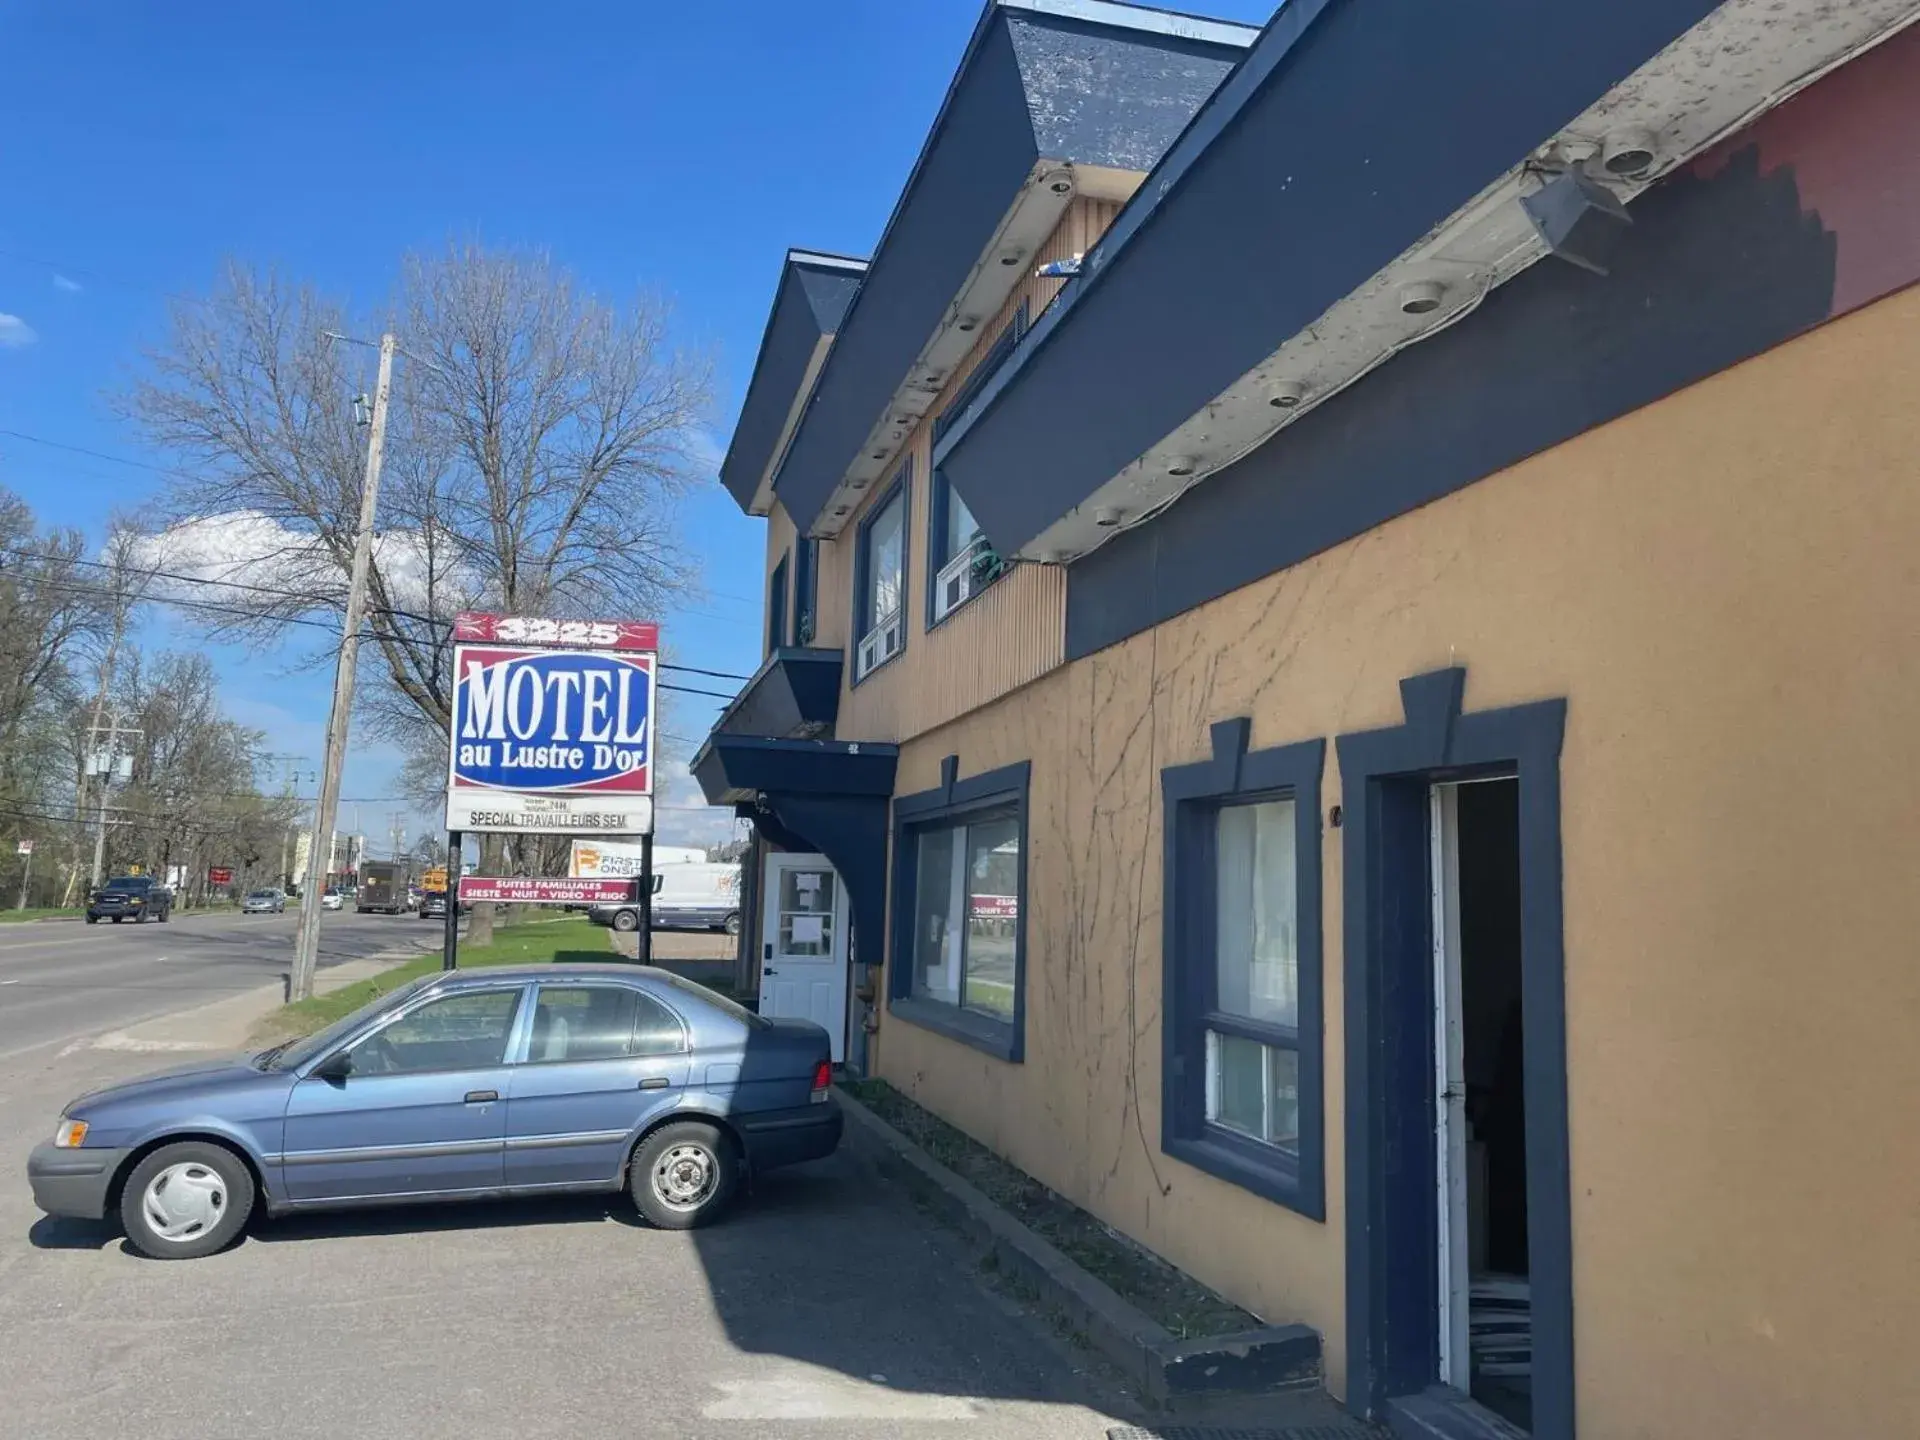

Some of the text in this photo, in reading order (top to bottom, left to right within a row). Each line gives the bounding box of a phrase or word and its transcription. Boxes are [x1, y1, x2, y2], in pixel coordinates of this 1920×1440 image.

[495, 617, 620, 645] 3225
[462, 660, 646, 743] MOTEL
[460, 741, 644, 771] au Lustre D'or
[520, 813, 600, 829] TRAVAILLEURS
[466, 888, 501, 897] SIESTE
[511, 890, 539, 898] NUIT
[594, 891, 629, 900] FRIGO
[496, 880, 532, 889] SUITES
